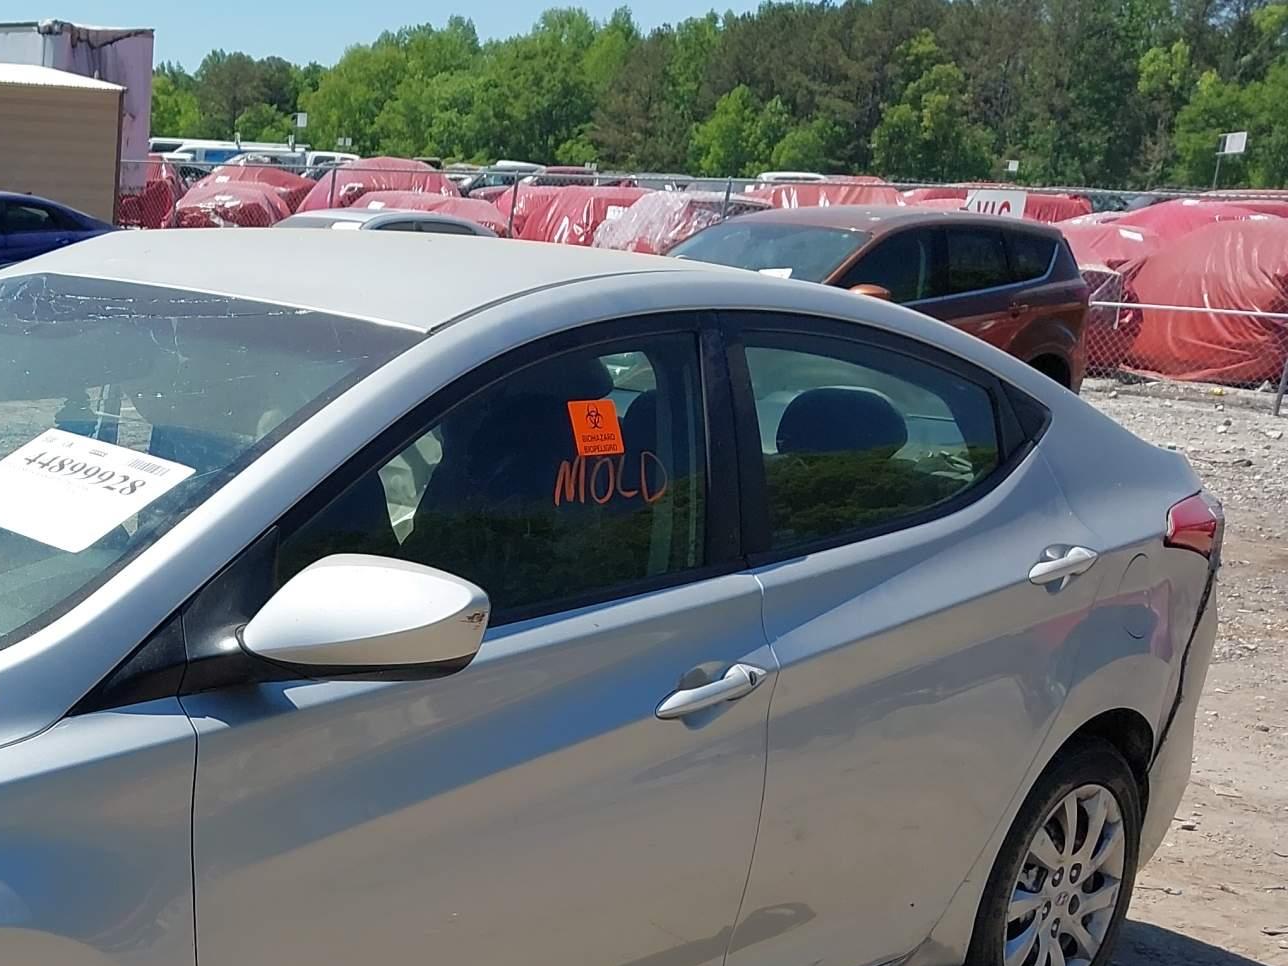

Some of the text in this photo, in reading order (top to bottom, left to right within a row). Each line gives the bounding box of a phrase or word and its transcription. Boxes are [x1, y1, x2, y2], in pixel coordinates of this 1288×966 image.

[582, 433, 616, 442] BIOHAZARD
[584, 444, 618, 453] BIOPELIGRO
[23, 450, 147, 496] 44899928
[555, 451, 668, 507] MOLD
